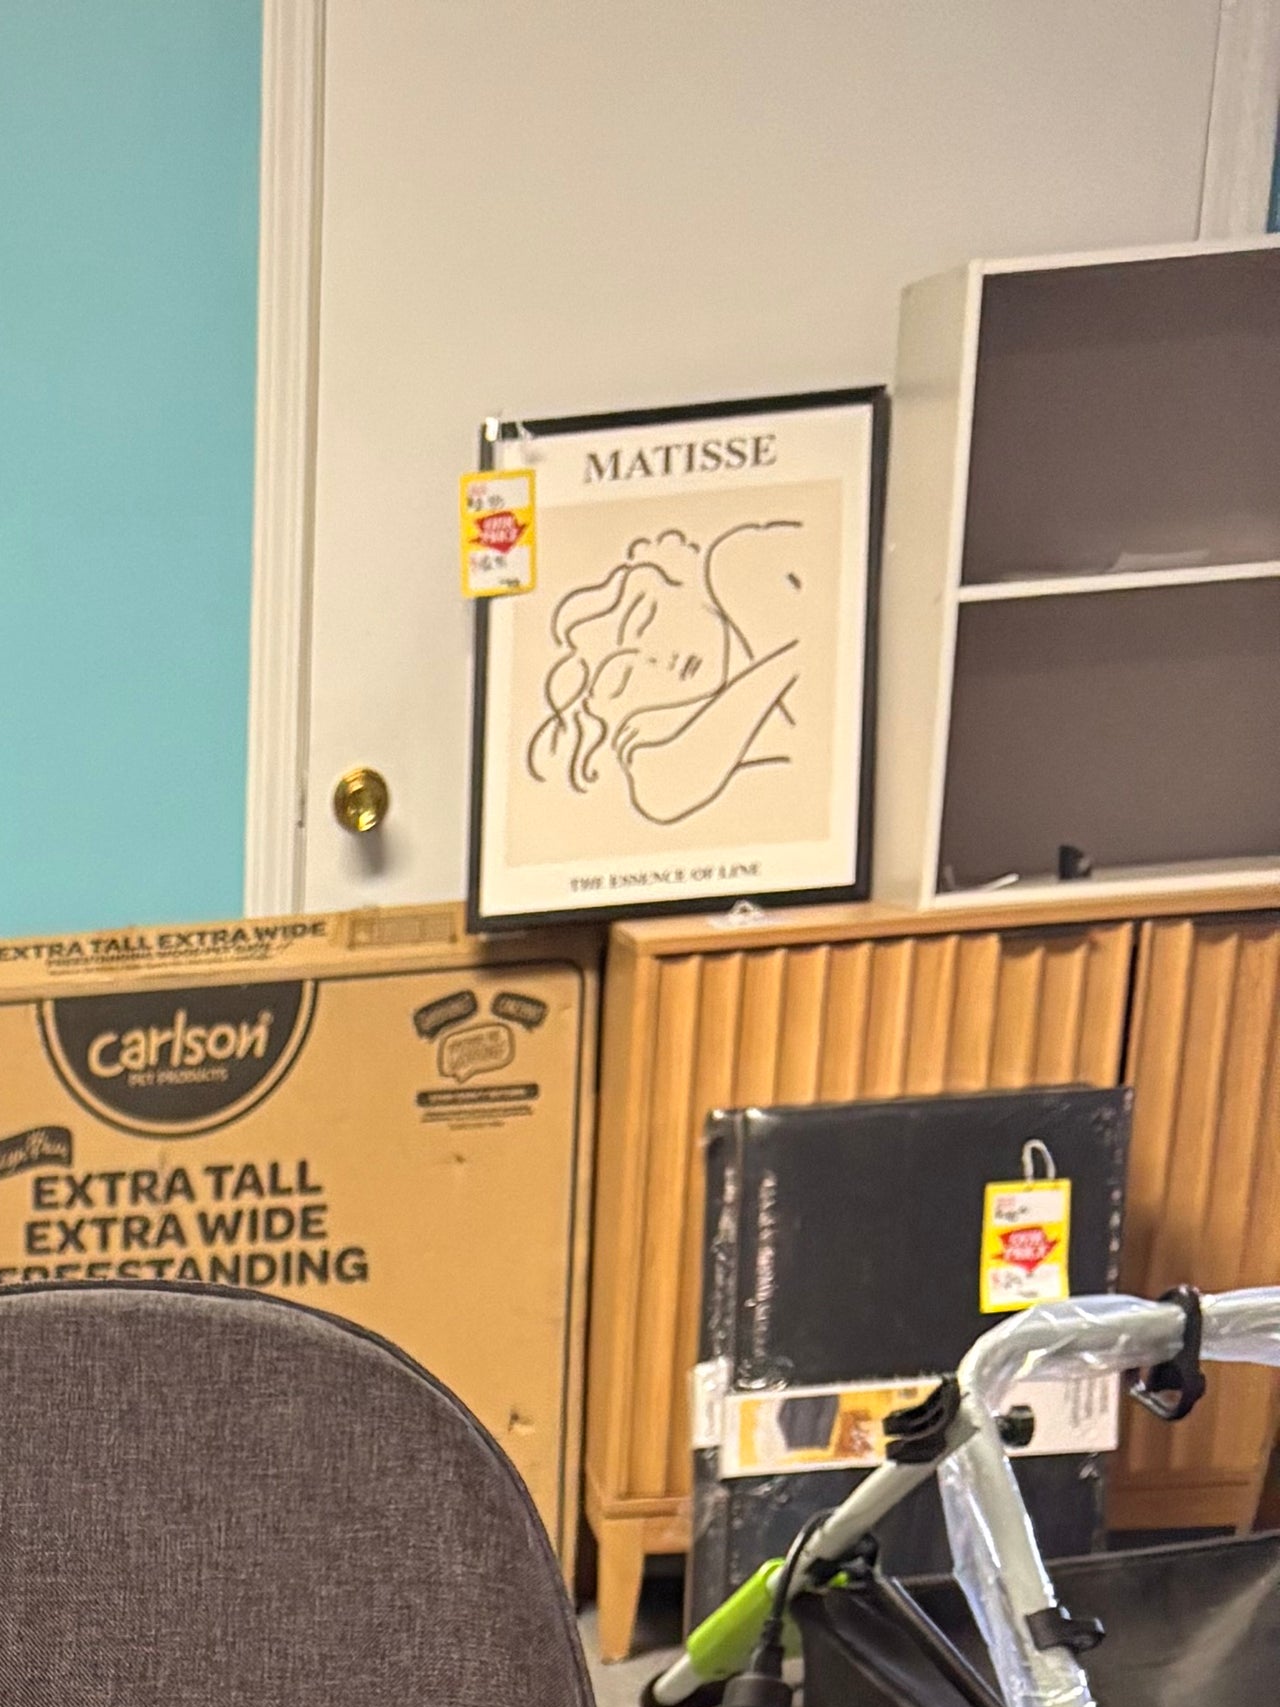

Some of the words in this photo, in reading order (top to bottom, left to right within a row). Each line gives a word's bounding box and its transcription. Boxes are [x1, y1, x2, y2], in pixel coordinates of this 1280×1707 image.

[584, 434, 777, 483] MATISSE
[609, 868, 685, 889] ESSENCE
[89, 936, 152, 956] TALL
[157, 927, 253, 951] EXTRA
[253, 921, 327, 942] WIDE
[87, 1008, 272, 1079] carlson
[32, 1166, 195, 1210] EXTRA
[205, 1158, 322, 1201] TALL
[25, 1211, 187, 1255] EXTRA
[196, 1204, 329, 1246] WIDE
